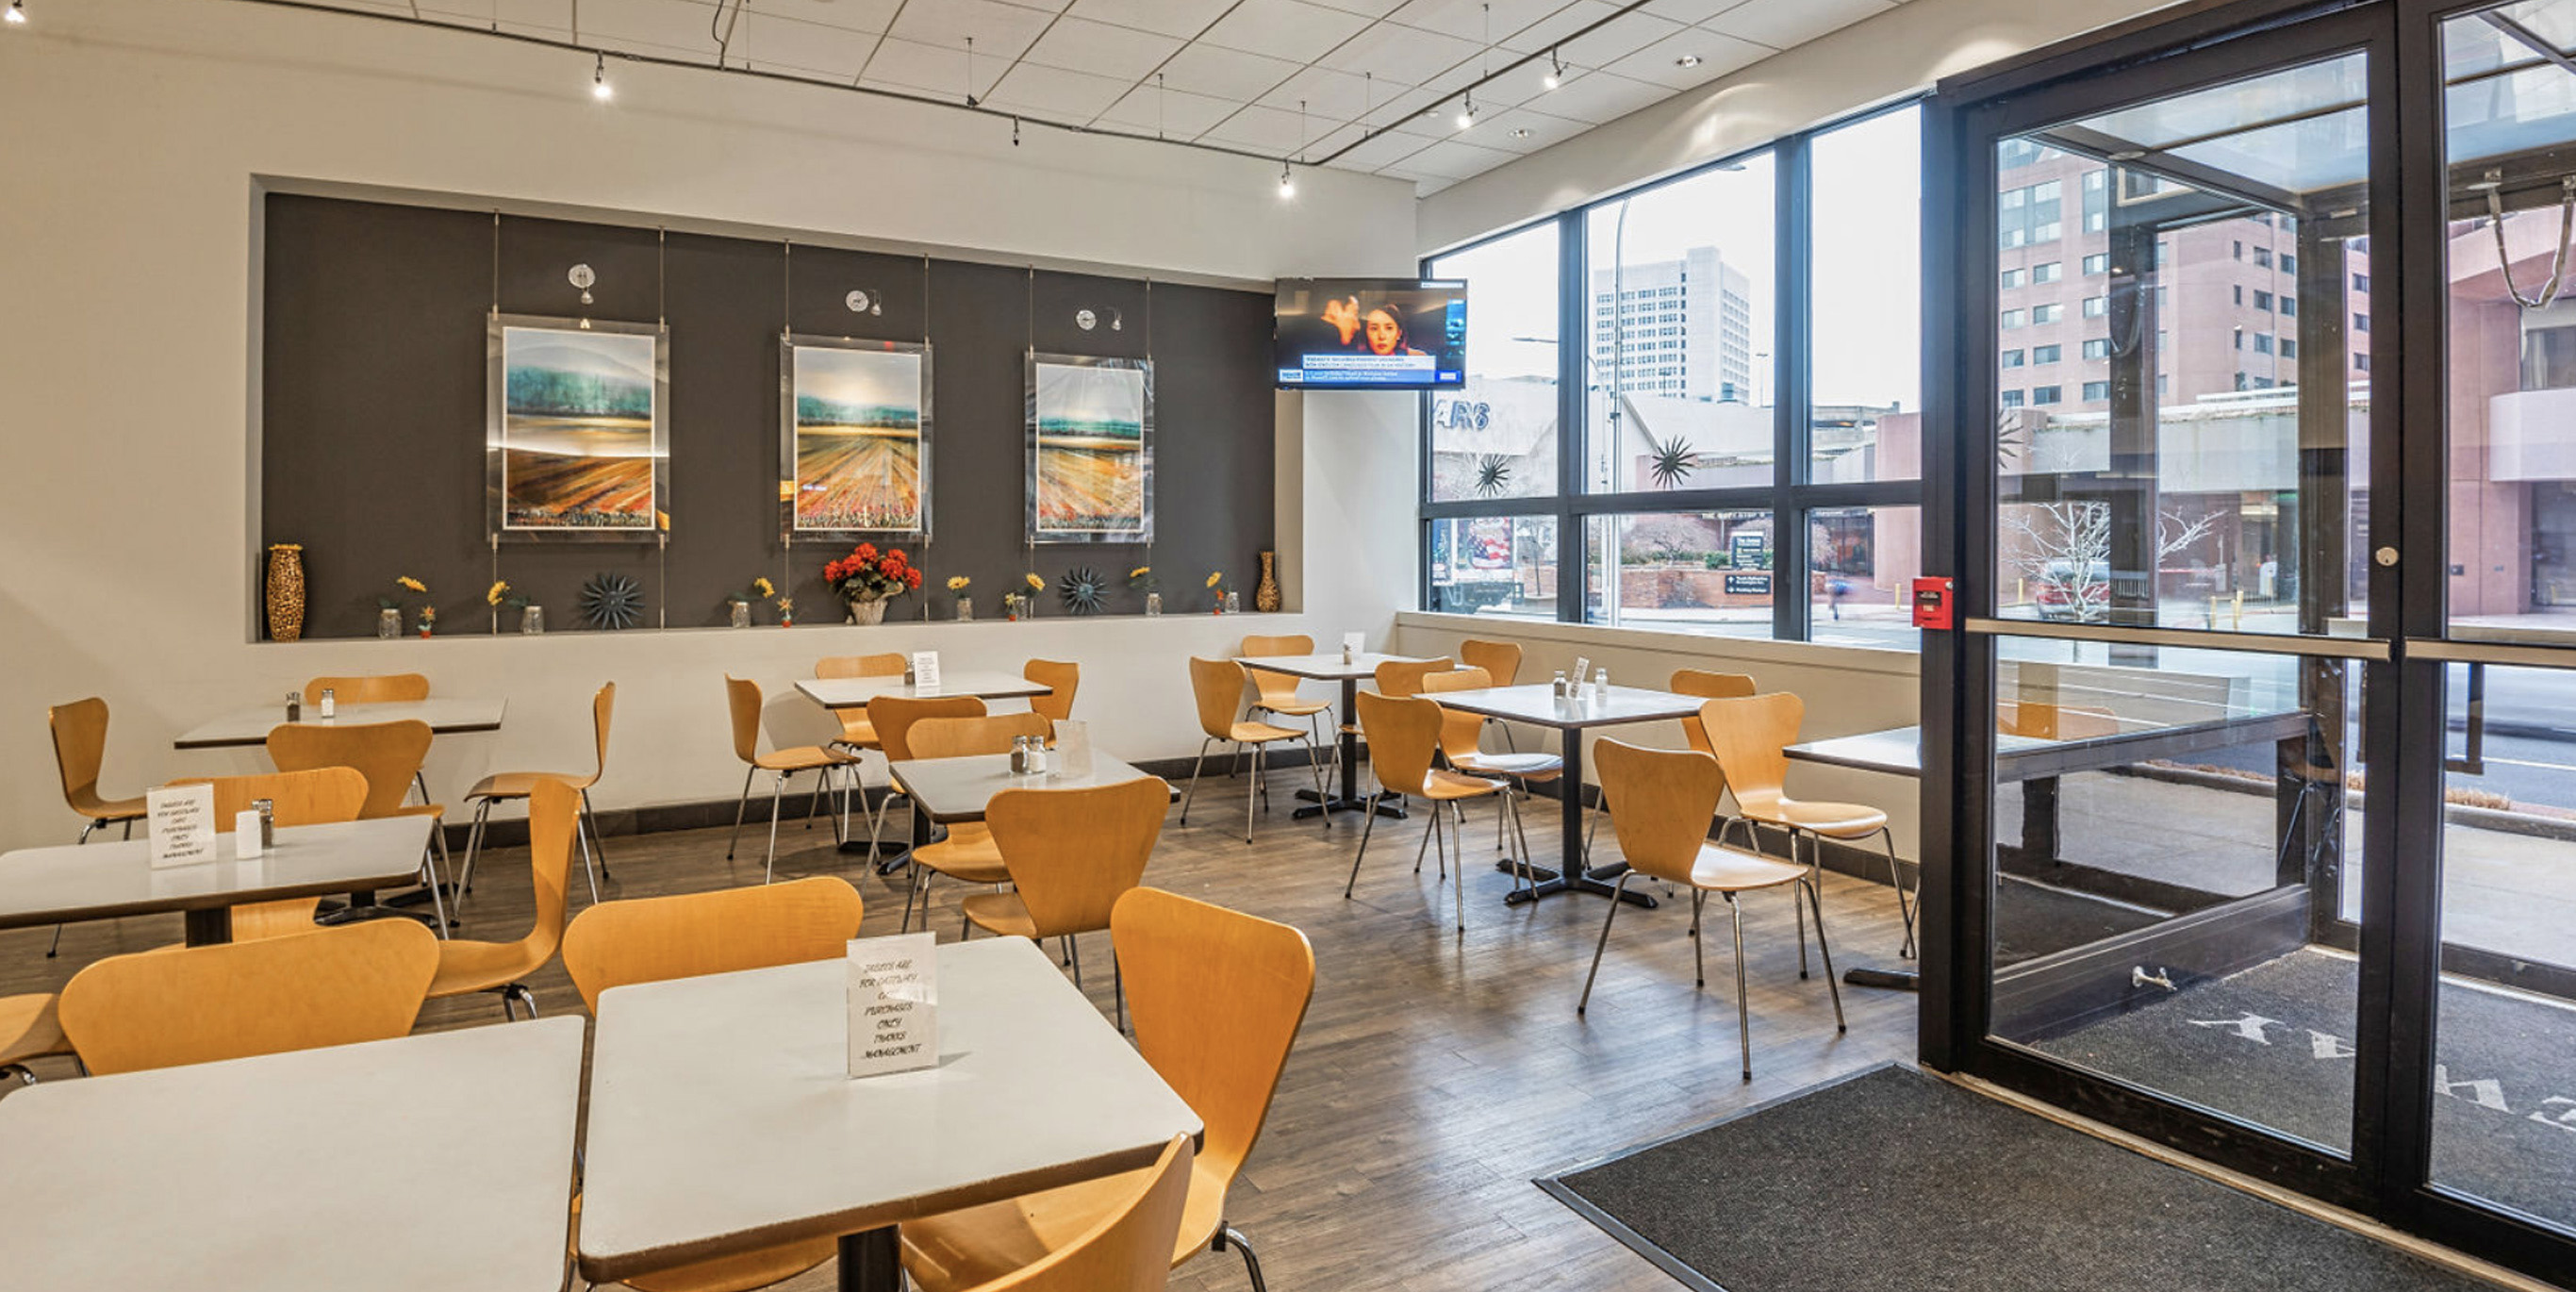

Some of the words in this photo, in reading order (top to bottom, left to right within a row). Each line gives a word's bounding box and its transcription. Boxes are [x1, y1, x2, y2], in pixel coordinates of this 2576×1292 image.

[865, 1001, 914, 1016] PURCHASES
[877, 1018, 902, 1029] ONLY
[874, 1032, 907, 1044] THANKS
[865, 1043, 922, 1059] MANAGEMENT
